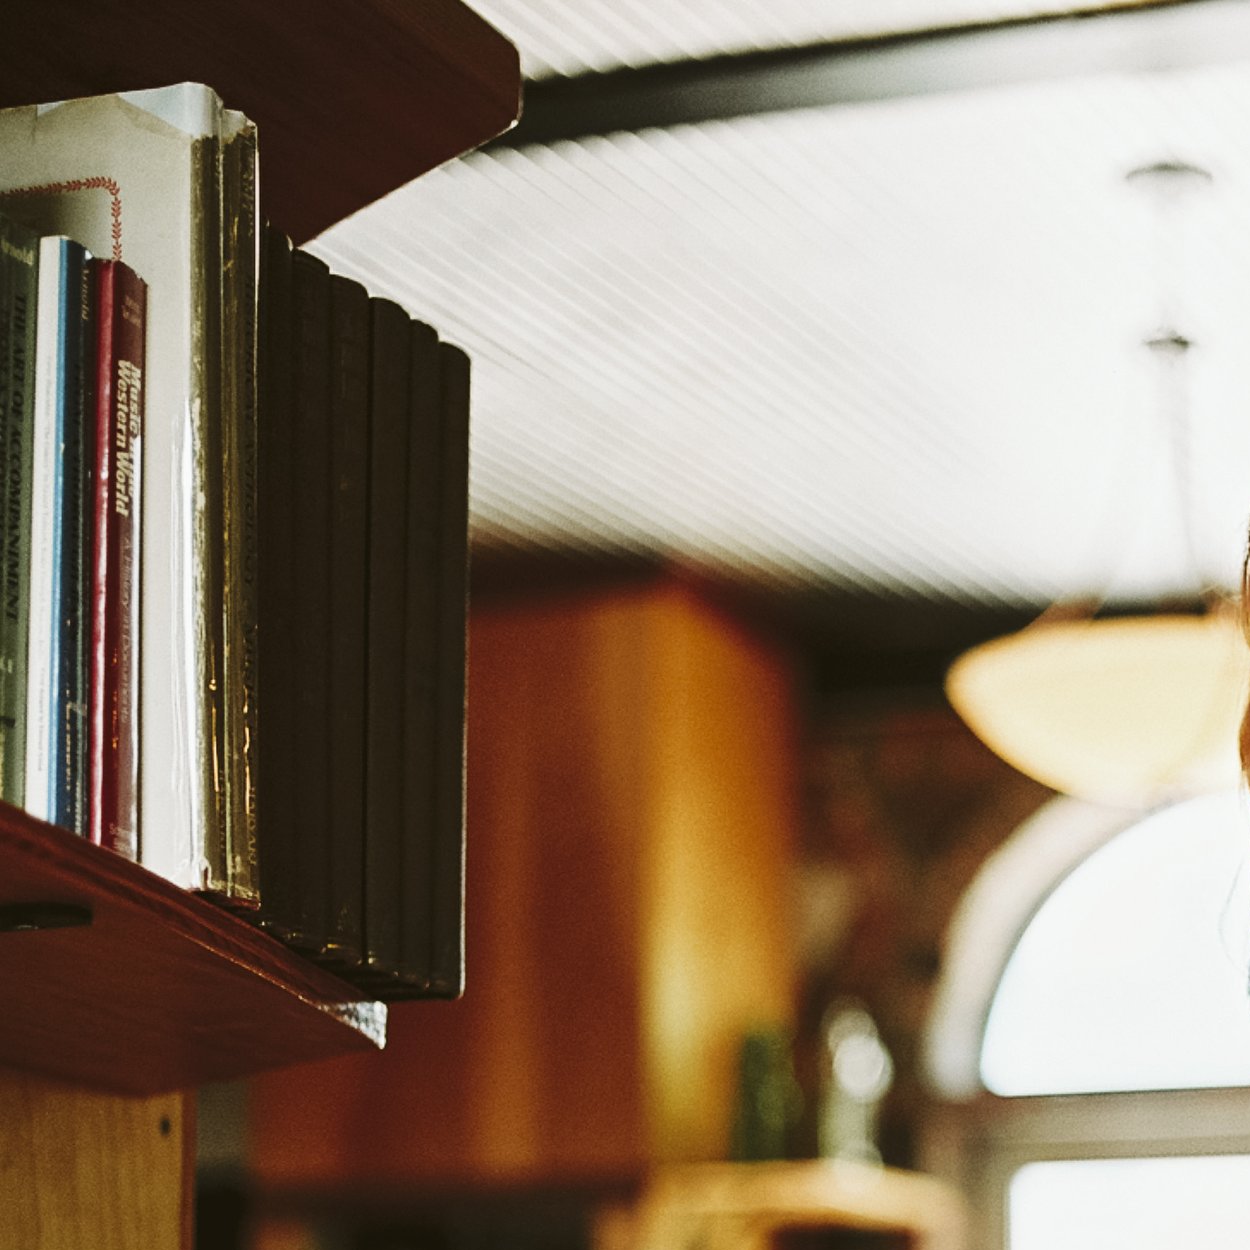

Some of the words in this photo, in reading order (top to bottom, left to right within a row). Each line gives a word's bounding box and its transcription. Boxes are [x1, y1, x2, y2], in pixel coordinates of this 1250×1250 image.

[14, 294, 27, 332] THE
[13, 347, 26, 383] ART
[12, 391, 25, 421] OF
[116, 360, 131, 448] Western
[129, 364, 142, 436] Music
[115, 452, 130, 517] World
[6, 427, 22, 621] ACCOMPANIMENT
